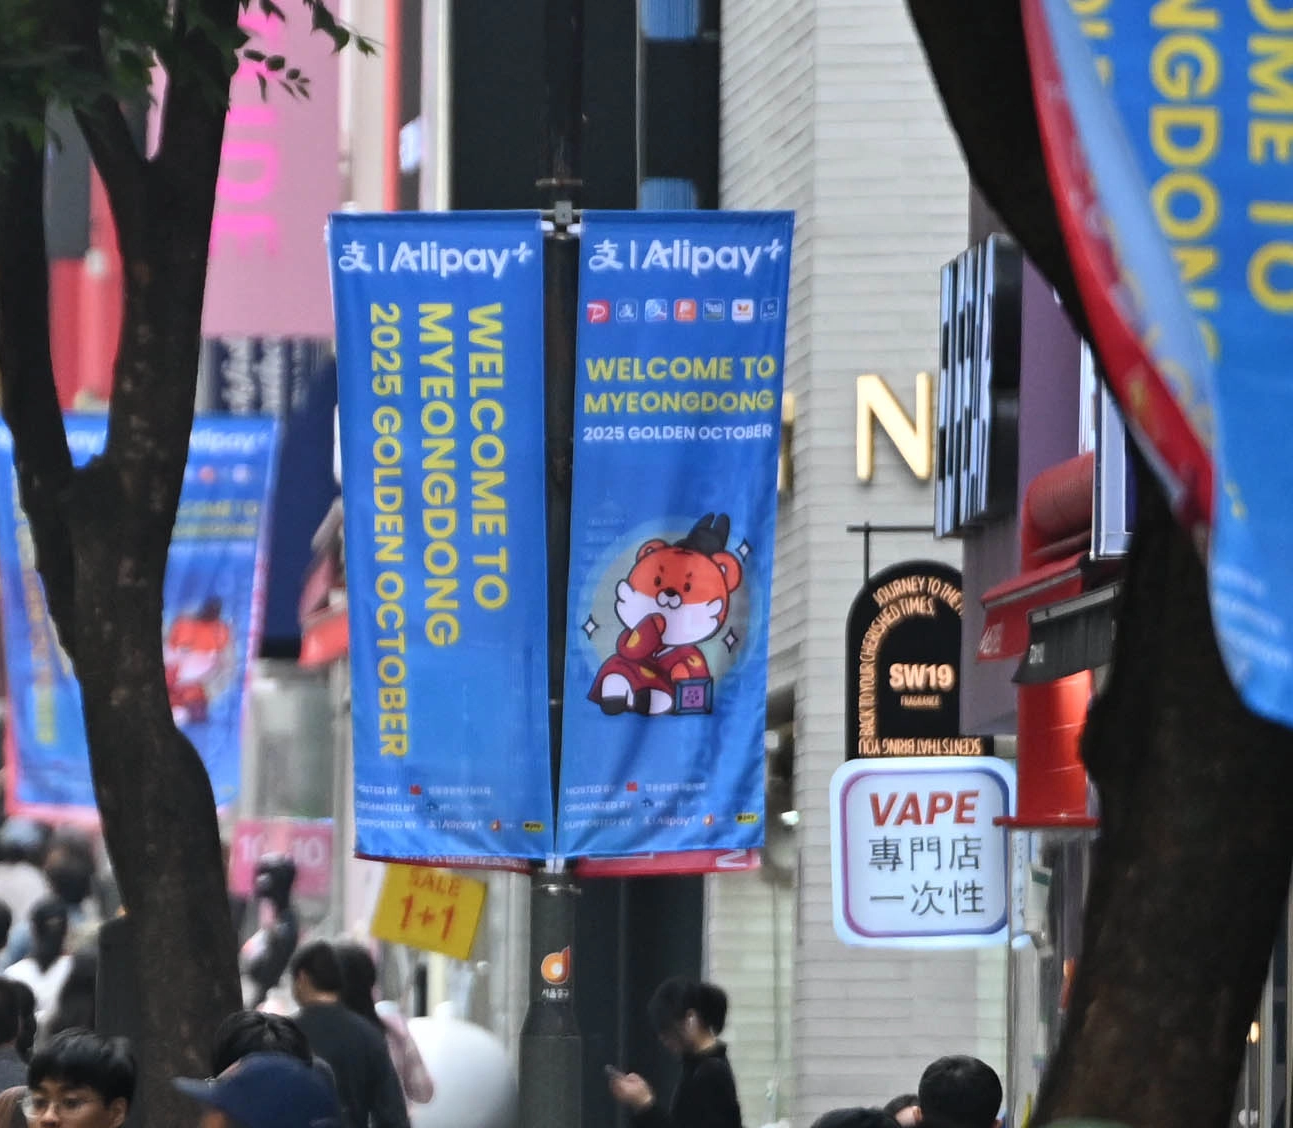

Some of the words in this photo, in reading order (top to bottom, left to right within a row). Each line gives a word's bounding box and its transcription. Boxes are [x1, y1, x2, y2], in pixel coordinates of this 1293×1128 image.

[390, 241, 533, 277] Alipay+
[641, 237, 784, 276] Alipay+
[370, 303, 403, 396] 2025
[585, 358, 733, 383] WELCOME
[741, 355, 777, 380] TO
[467, 302, 508, 536] WELCOME
[583, 390, 775, 414] MYEONGDONG
[583, 425, 624, 441] 2025
[628, 425, 696, 440] GOLDEN
[699, 423, 773, 441] OCTOBER
[371, 406, 404, 565] GOLDEN
[418, 303, 460, 646] MYEONGDONG
[472, 546, 509, 610] TO
[873, 576, 926, 606] JOURNEY
[928, 576, 943, 594] TO
[374, 571, 408, 757] OCTOBER
[859, 662, 875, 692] YOUR
[889, 663, 954, 692] SW19
[859, 709, 875, 737] BACK
[859, 737, 881, 755] YOU
[882, 737, 915, 755] BRING
[916, 737, 942, 755] THAT
[942, 737, 981, 755] SCENTS
[868, 789, 980, 828] VAPE
[868, 836, 982, 871] 專門店
[868, 882, 985, 916] 一次性
[400, 895, 456, 941] 1+1
